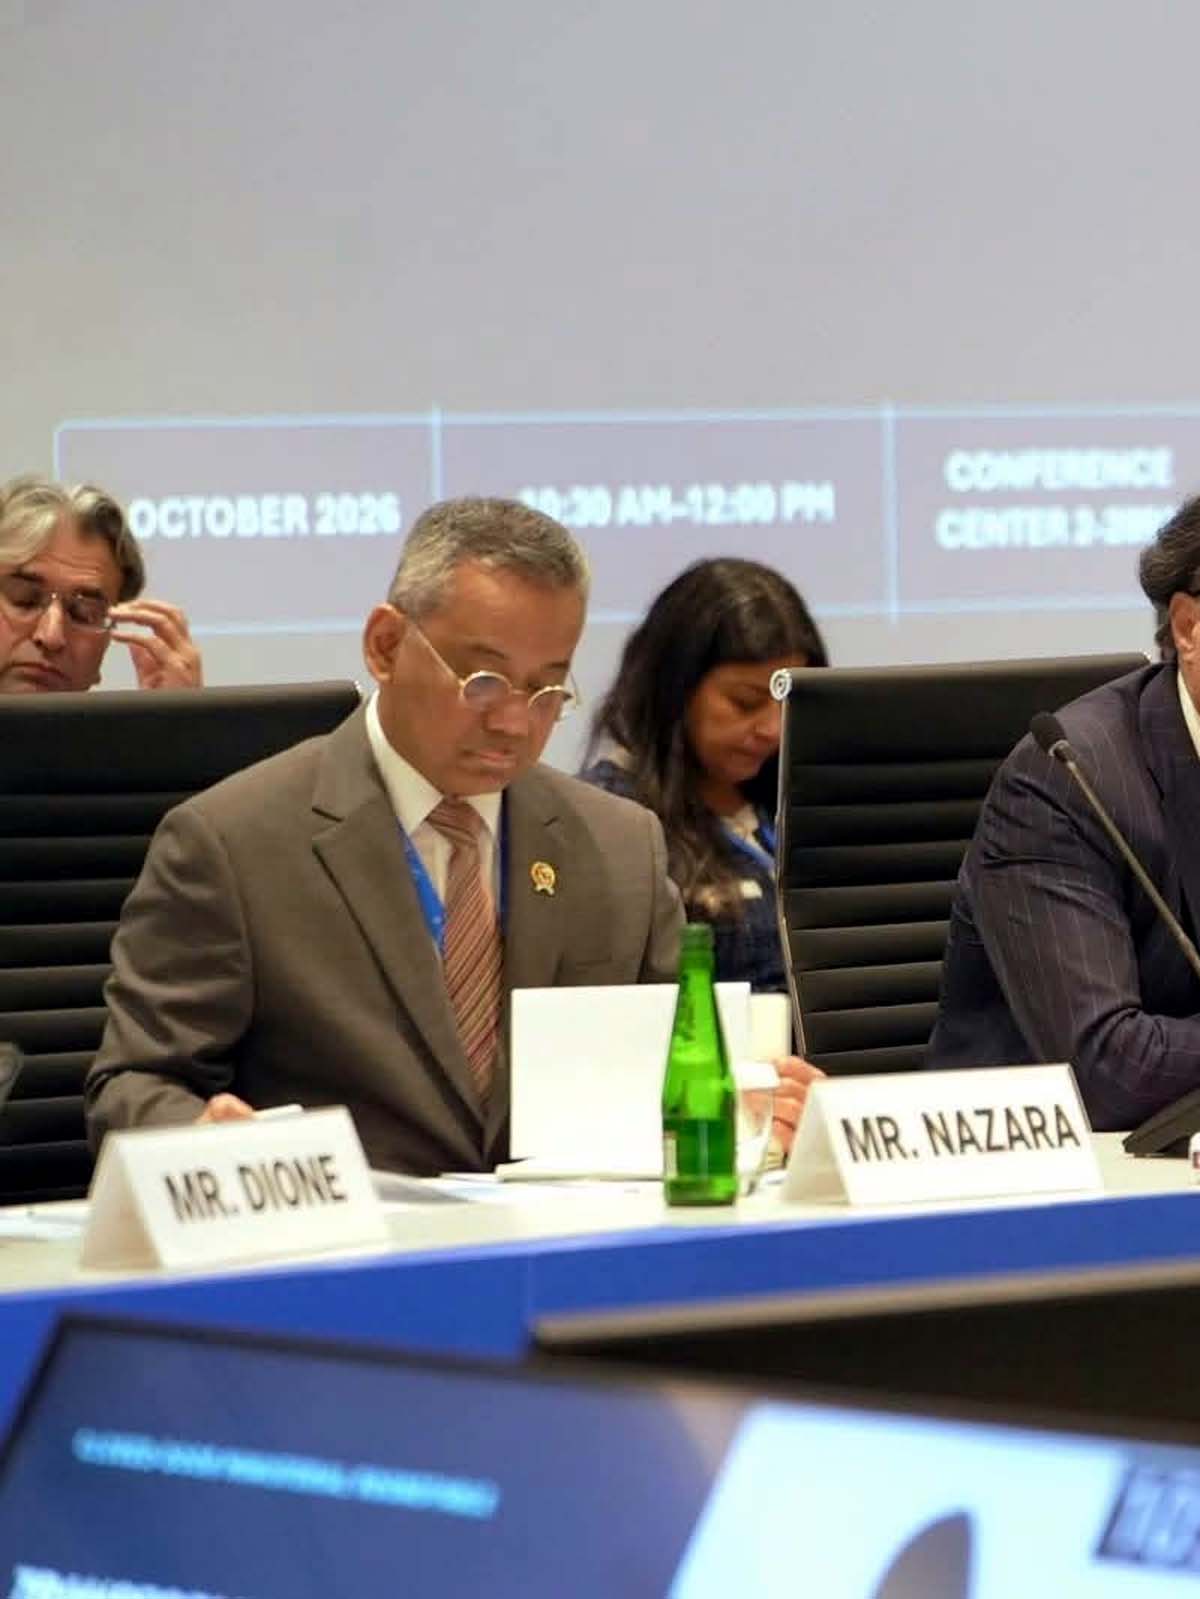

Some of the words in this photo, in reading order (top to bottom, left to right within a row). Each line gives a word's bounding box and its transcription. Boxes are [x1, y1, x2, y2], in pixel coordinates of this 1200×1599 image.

[946, 447, 1172, 491] CONFERENCE
[128, 495, 308, 538] OCTOBER
[315, 493, 401, 534] 2026
[782, 481, 835, 519] PM
[936, 506, 1069, 548] CENTER
[841, 1116, 919, 1163] MR.
[921, 1103, 1081, 1156] NAZARA
[163, 1170, 239, 1222] MR.
[237, 1155, 347, 1212] DIONE
